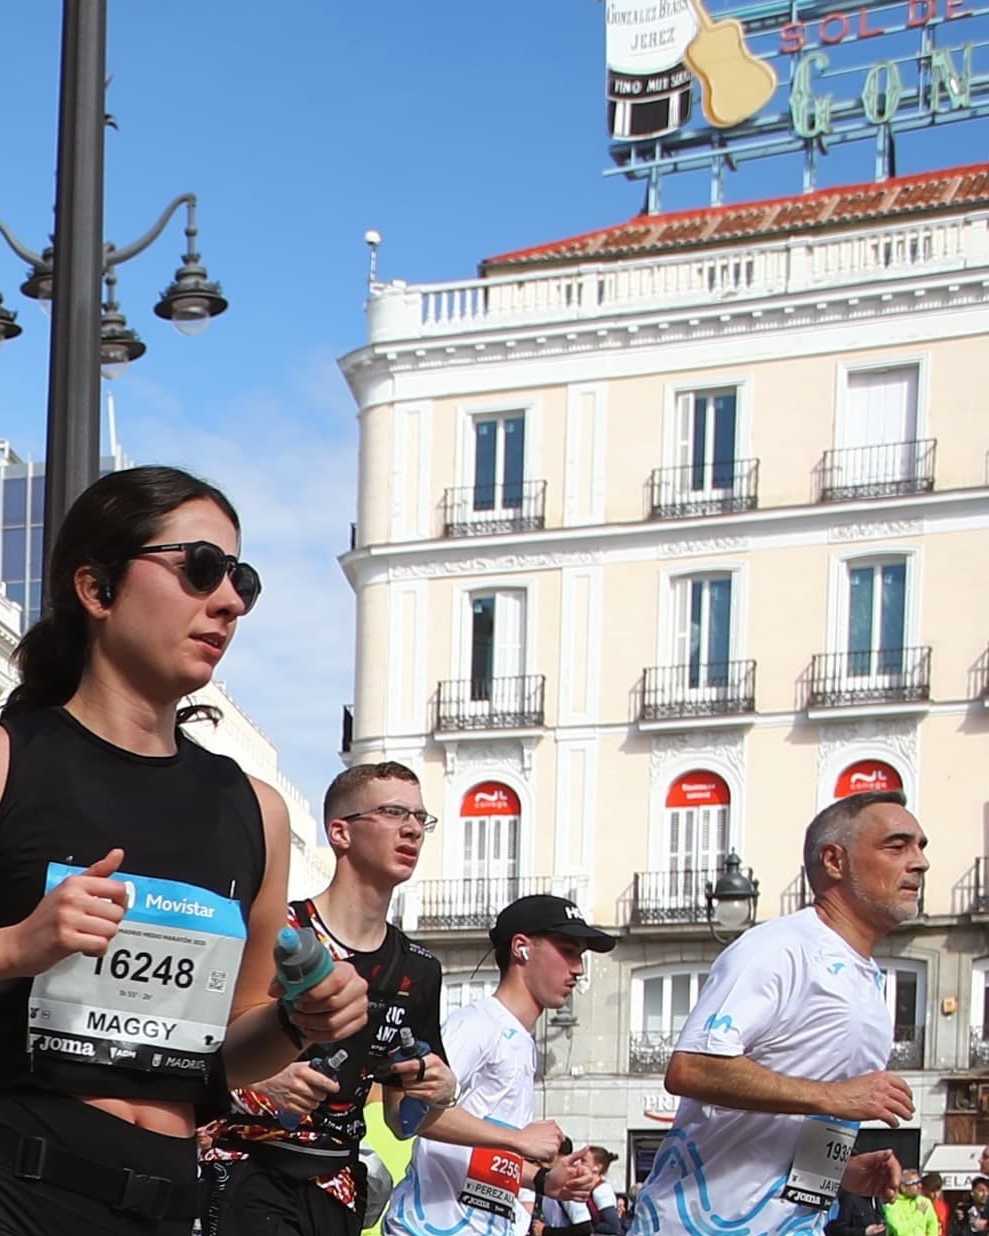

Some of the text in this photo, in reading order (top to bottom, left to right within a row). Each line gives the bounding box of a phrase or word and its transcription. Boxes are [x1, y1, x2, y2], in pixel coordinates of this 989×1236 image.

[630, 27, 675, 50] JEREZ
[780, 8, 885, 54] SOL
[145, 893, 215, 919] Movistar
[94, 948, 195, 989] 16248
[86, 1011, 177, 1041] MAGGY
[474, 1183, 504, 1201] PEREZ
